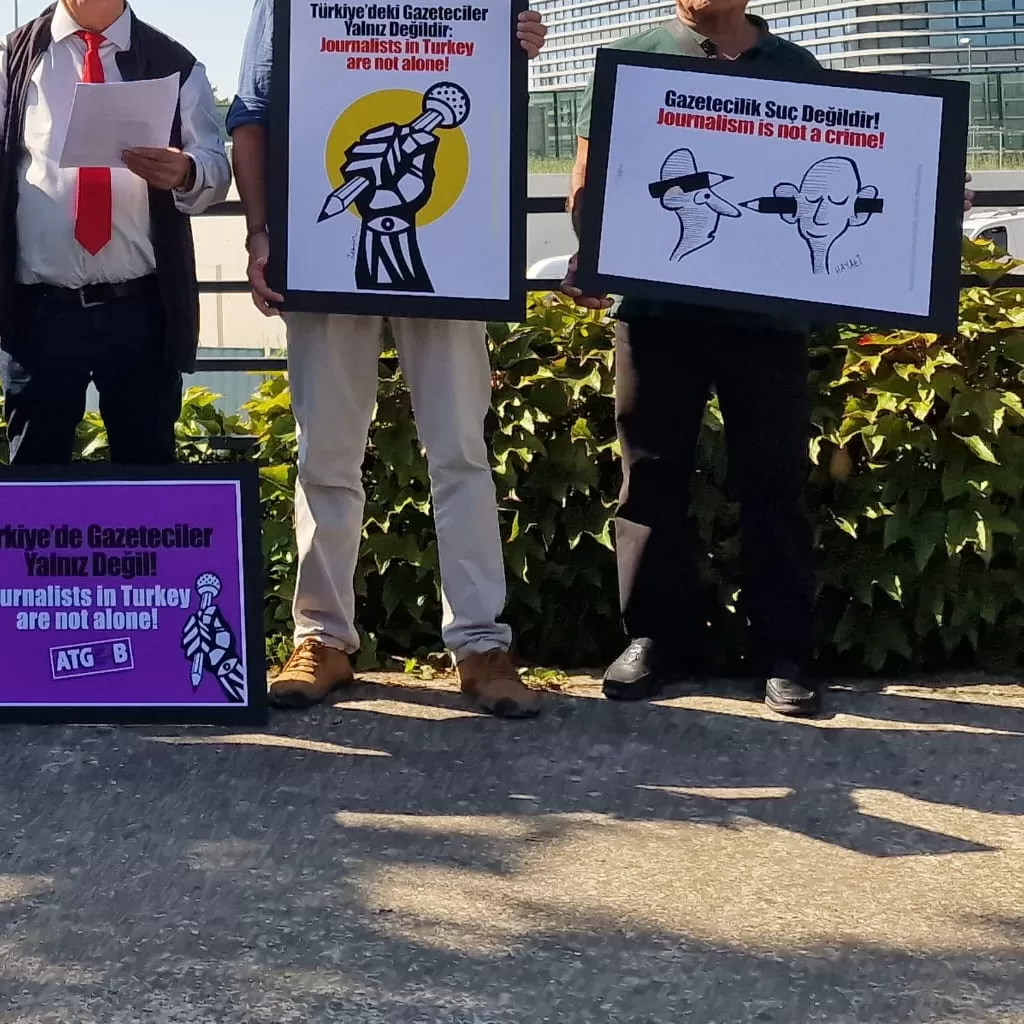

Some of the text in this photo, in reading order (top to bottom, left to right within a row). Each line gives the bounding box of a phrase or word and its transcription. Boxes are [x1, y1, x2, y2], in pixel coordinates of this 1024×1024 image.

[310, 3, 489, 22] Türkiye'deki Gazeteciler
[344, 20, 453, 39] Yalnız Değildir:
[320, 37, 474, 57] Journalists in Turkey
[346, 56, 450, 72] are not alone!
[664, 89, 880, 129] Gazetecilik Suç Değildir!
[656, 108, 885, 150] Journalism is not a crime!
[87, 524, 214, 549] Gazeteciler
[23, 551, 158, 580] Yalnız Değil!
[96, 585, 117, 607] in
[120, 585, 191, 609] Turkey
[16, 608, 159, 631] are not alone!
